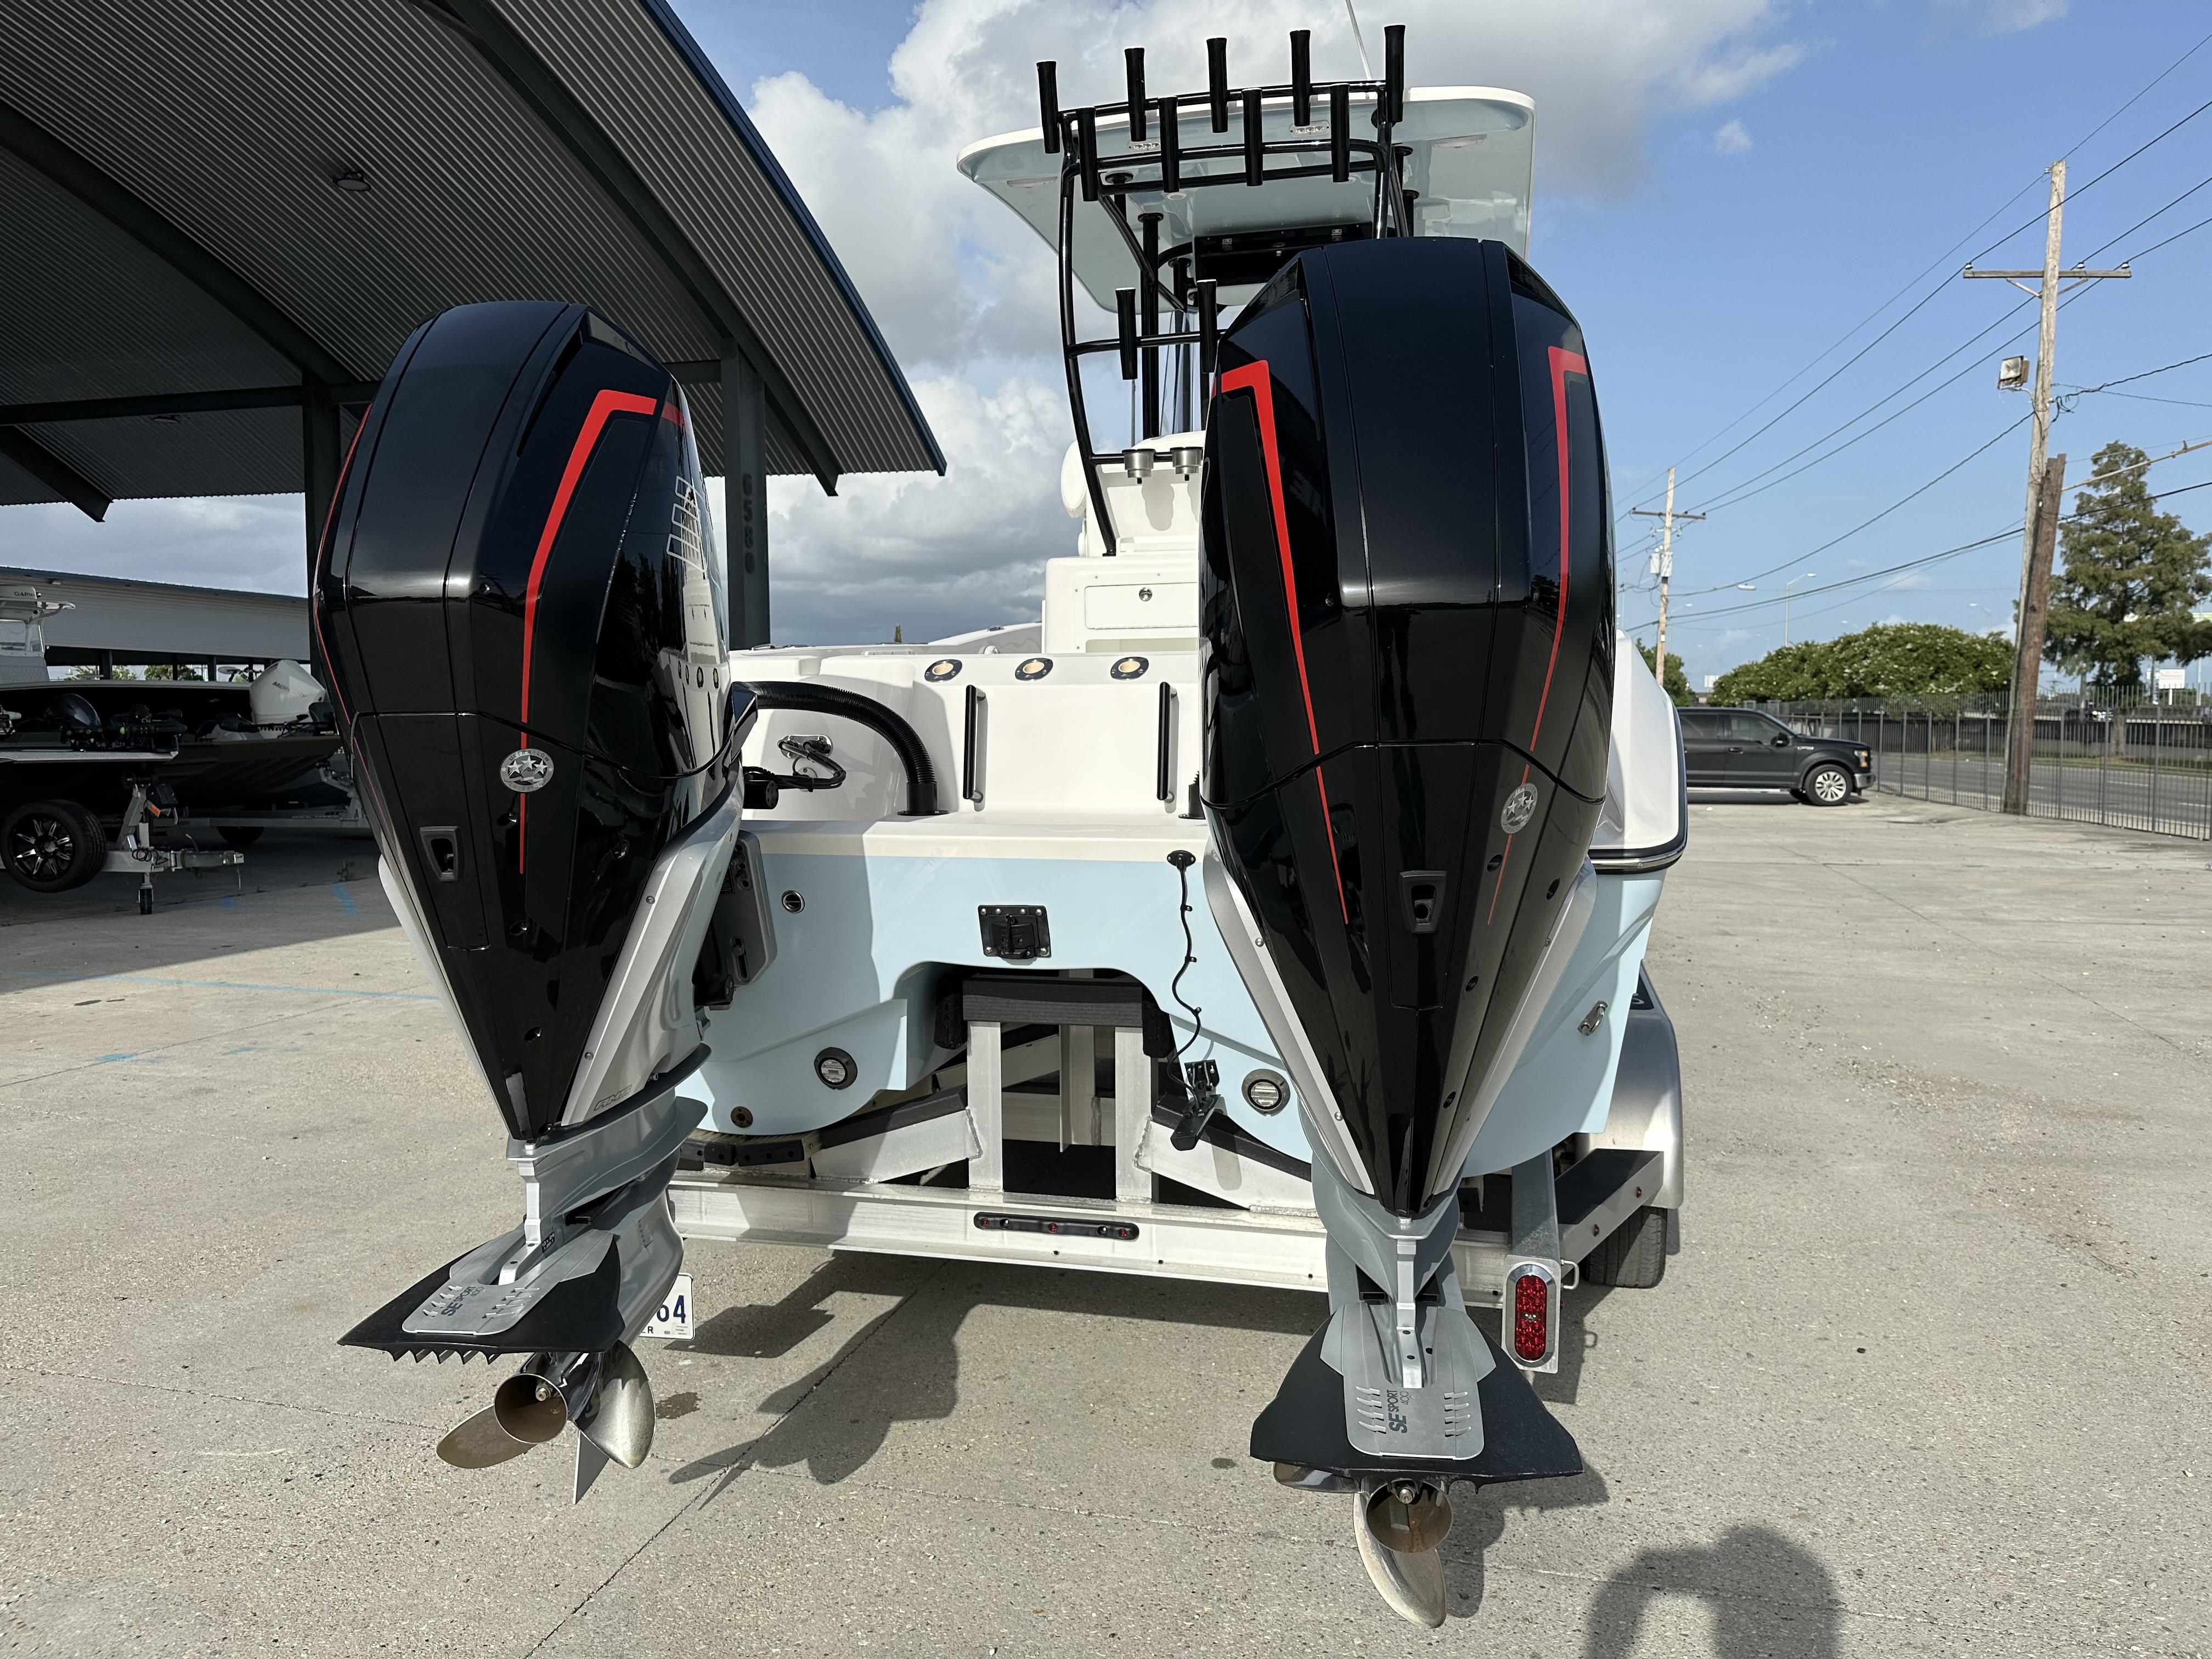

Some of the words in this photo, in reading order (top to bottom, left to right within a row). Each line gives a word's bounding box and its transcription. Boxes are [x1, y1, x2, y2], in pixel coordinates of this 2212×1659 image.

[742, 473, 755, 574] 6580
[509, 750, 531, 761] ULTRA
[537, 751, 550, 762] LOW
[441, 1302, 463, 1316] SE
[453, 1286, 476, 1302] SPORT
[1386, 1389, 1400, 1412] SPORT
[1400, 1391, 1409, 1405] 400
[1388, 1413, 1408, 1434] SE
